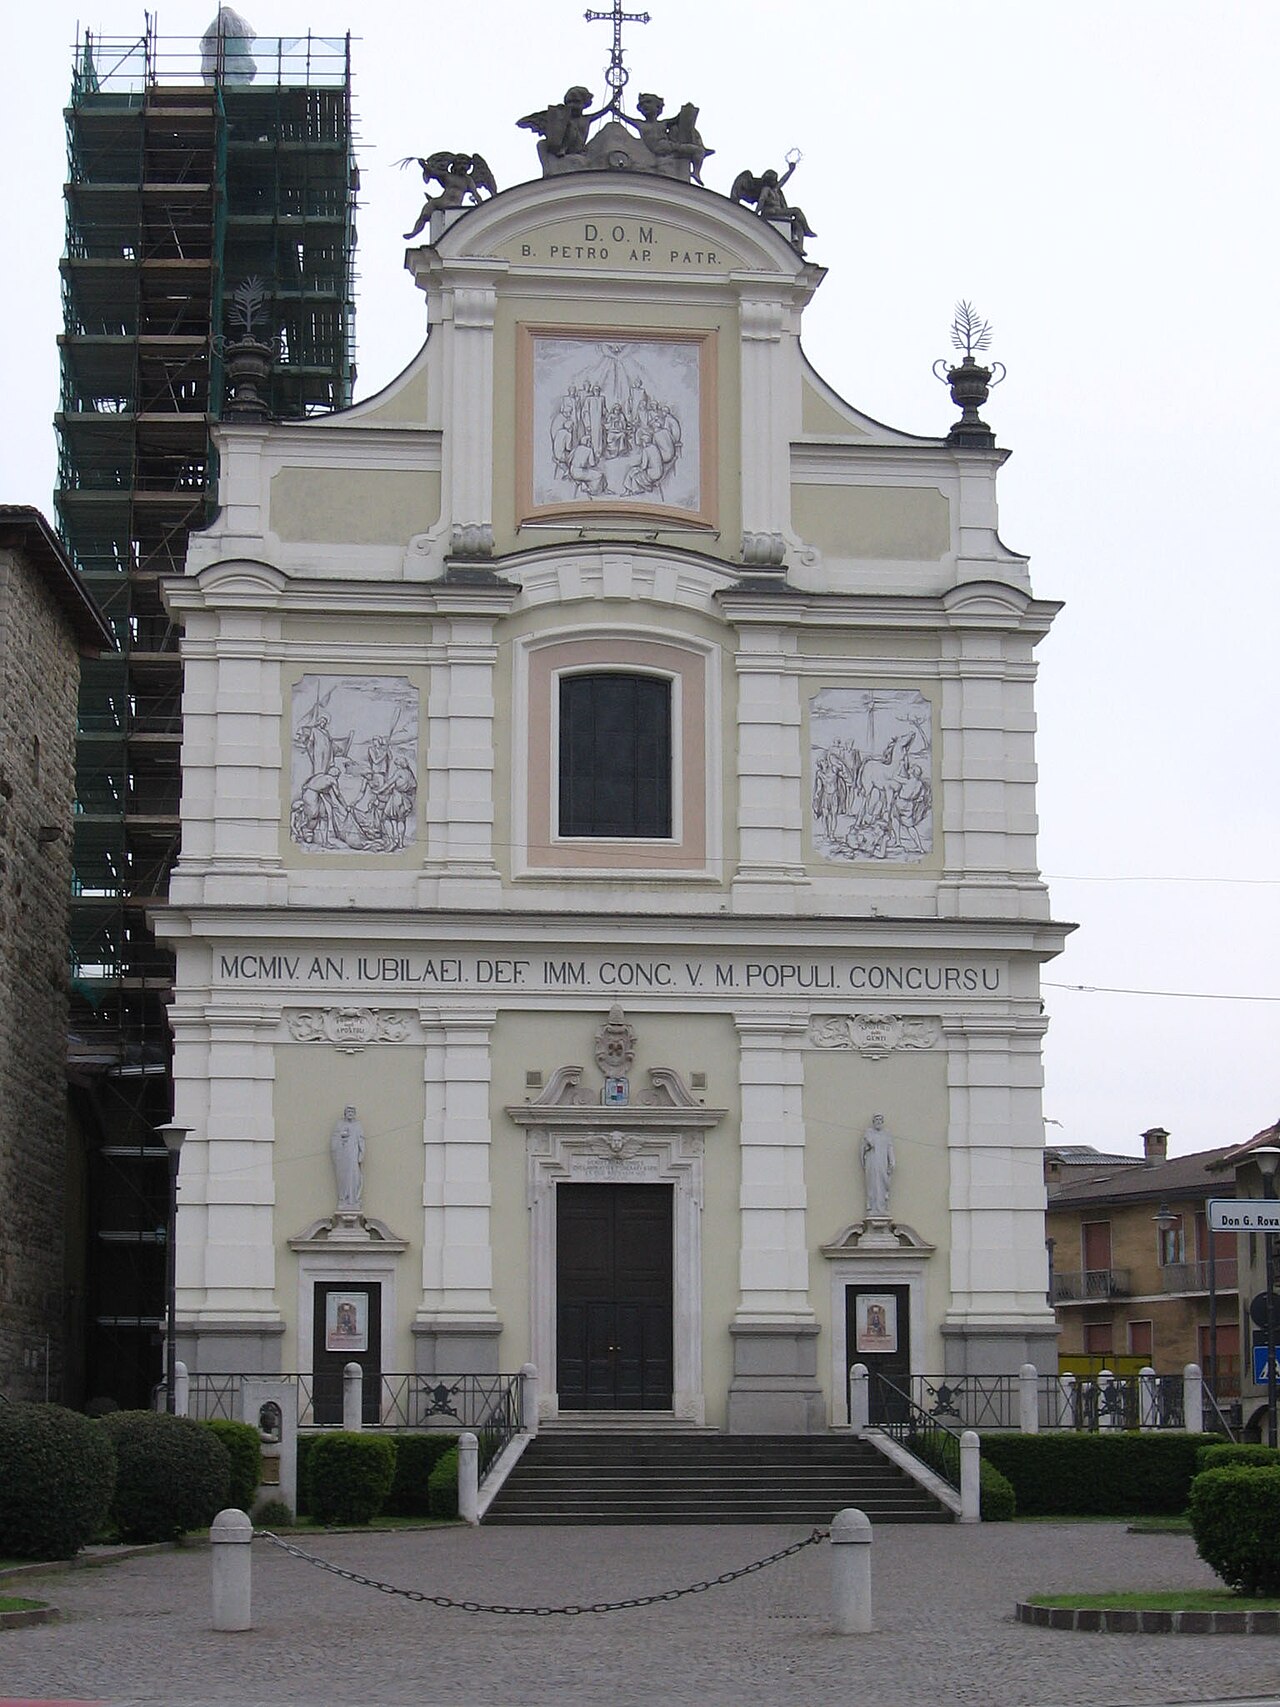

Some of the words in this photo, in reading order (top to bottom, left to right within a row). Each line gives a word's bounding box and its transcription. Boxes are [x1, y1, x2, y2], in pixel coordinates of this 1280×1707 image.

[521, 244, 537, 257] B.
[550, 245, 609, 260] PETRO
[629, 249, 651, 262] AP.
[670, 251, 721, 265] PATR.
[220, 955, 300, 980] MCMIV.
[307, 956, 350, 981] AN.
[357, 957, 469, 983] IUBILAEI.
[476, 959, 531, 984] DEF.
[544, 961, 591, 985] IMM.
[599, 961, 676, 986] CONC.
[745, 964, 841, 989] POPULI.
[848, 965, 1000, 991] CONCURSU
[1221, 1215, 1240, 1226] Don
[1243, 1215, 1254, 1226] G.
